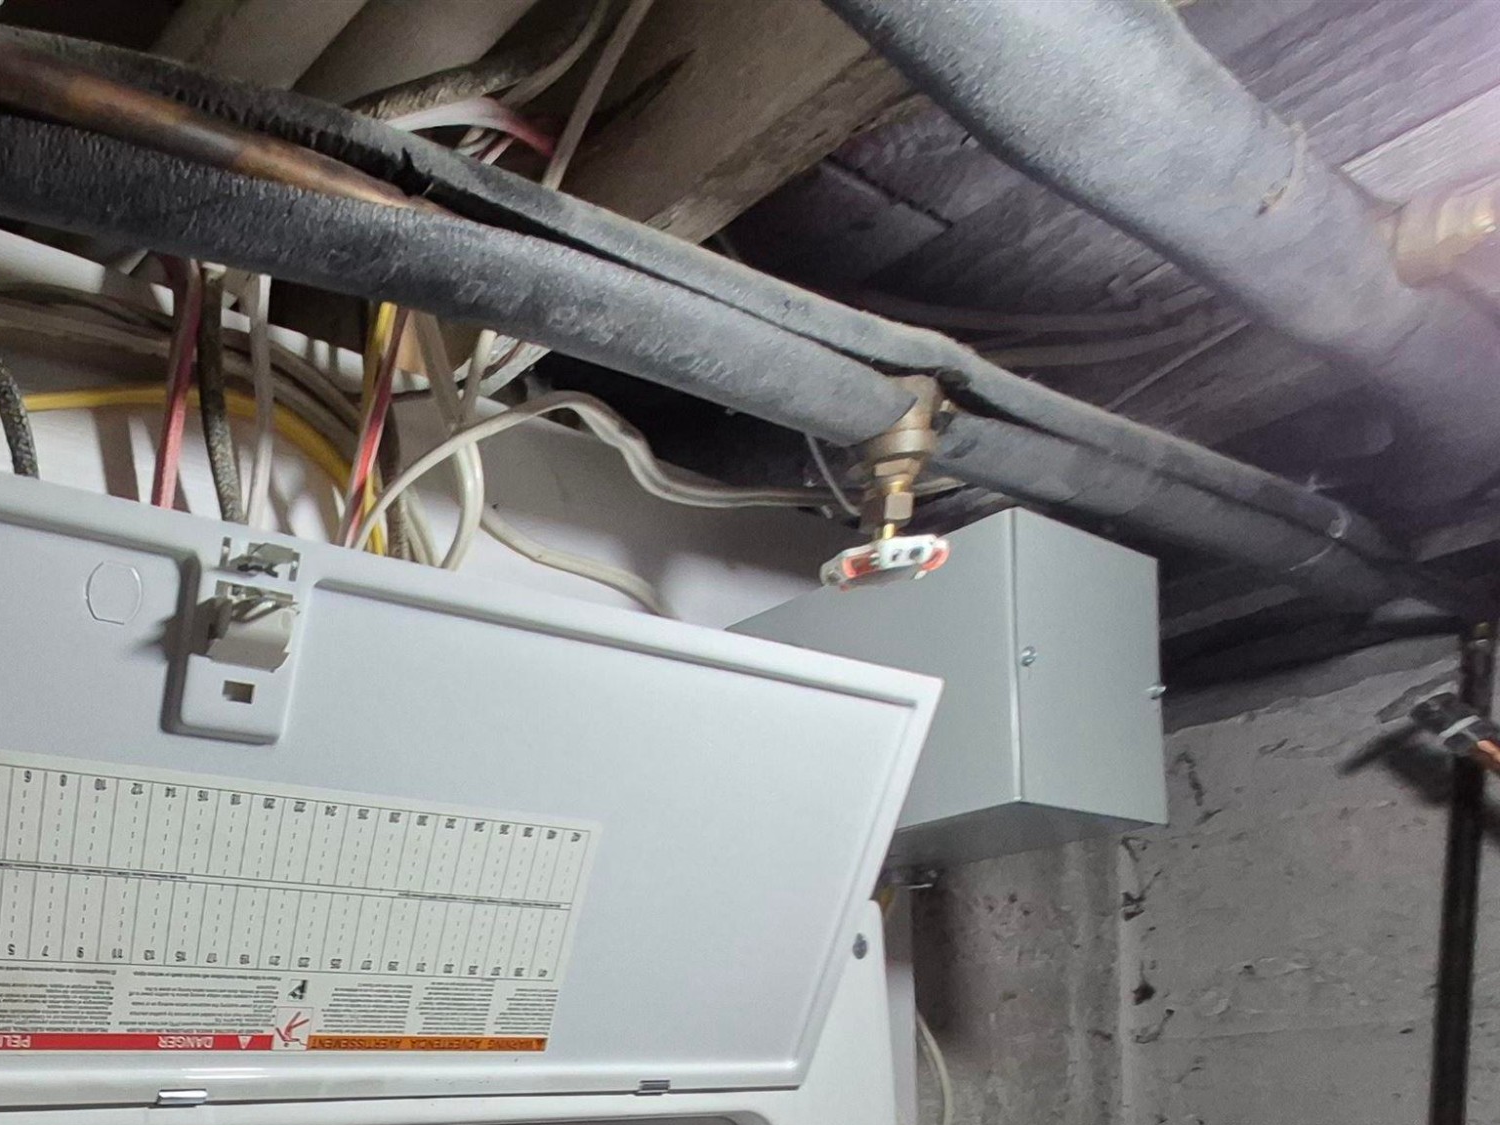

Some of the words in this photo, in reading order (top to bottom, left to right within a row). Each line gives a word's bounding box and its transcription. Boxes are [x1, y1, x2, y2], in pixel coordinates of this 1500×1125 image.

[131, 783, 143, 795] 12
[8, 944, 15, 955] 5
[42, 946, 49, 956] 7
[175, 951, 186, 961] 15
[206, 953, 217, 963] 17
[157, 1035, 214, 1048] DANGER
[309, 1037, 402, 1050] AVERTISSEMENT
[410, 1038, 481, 1050] ADVERTENCIA
[488, 1039, 534, 1050] WARNING
